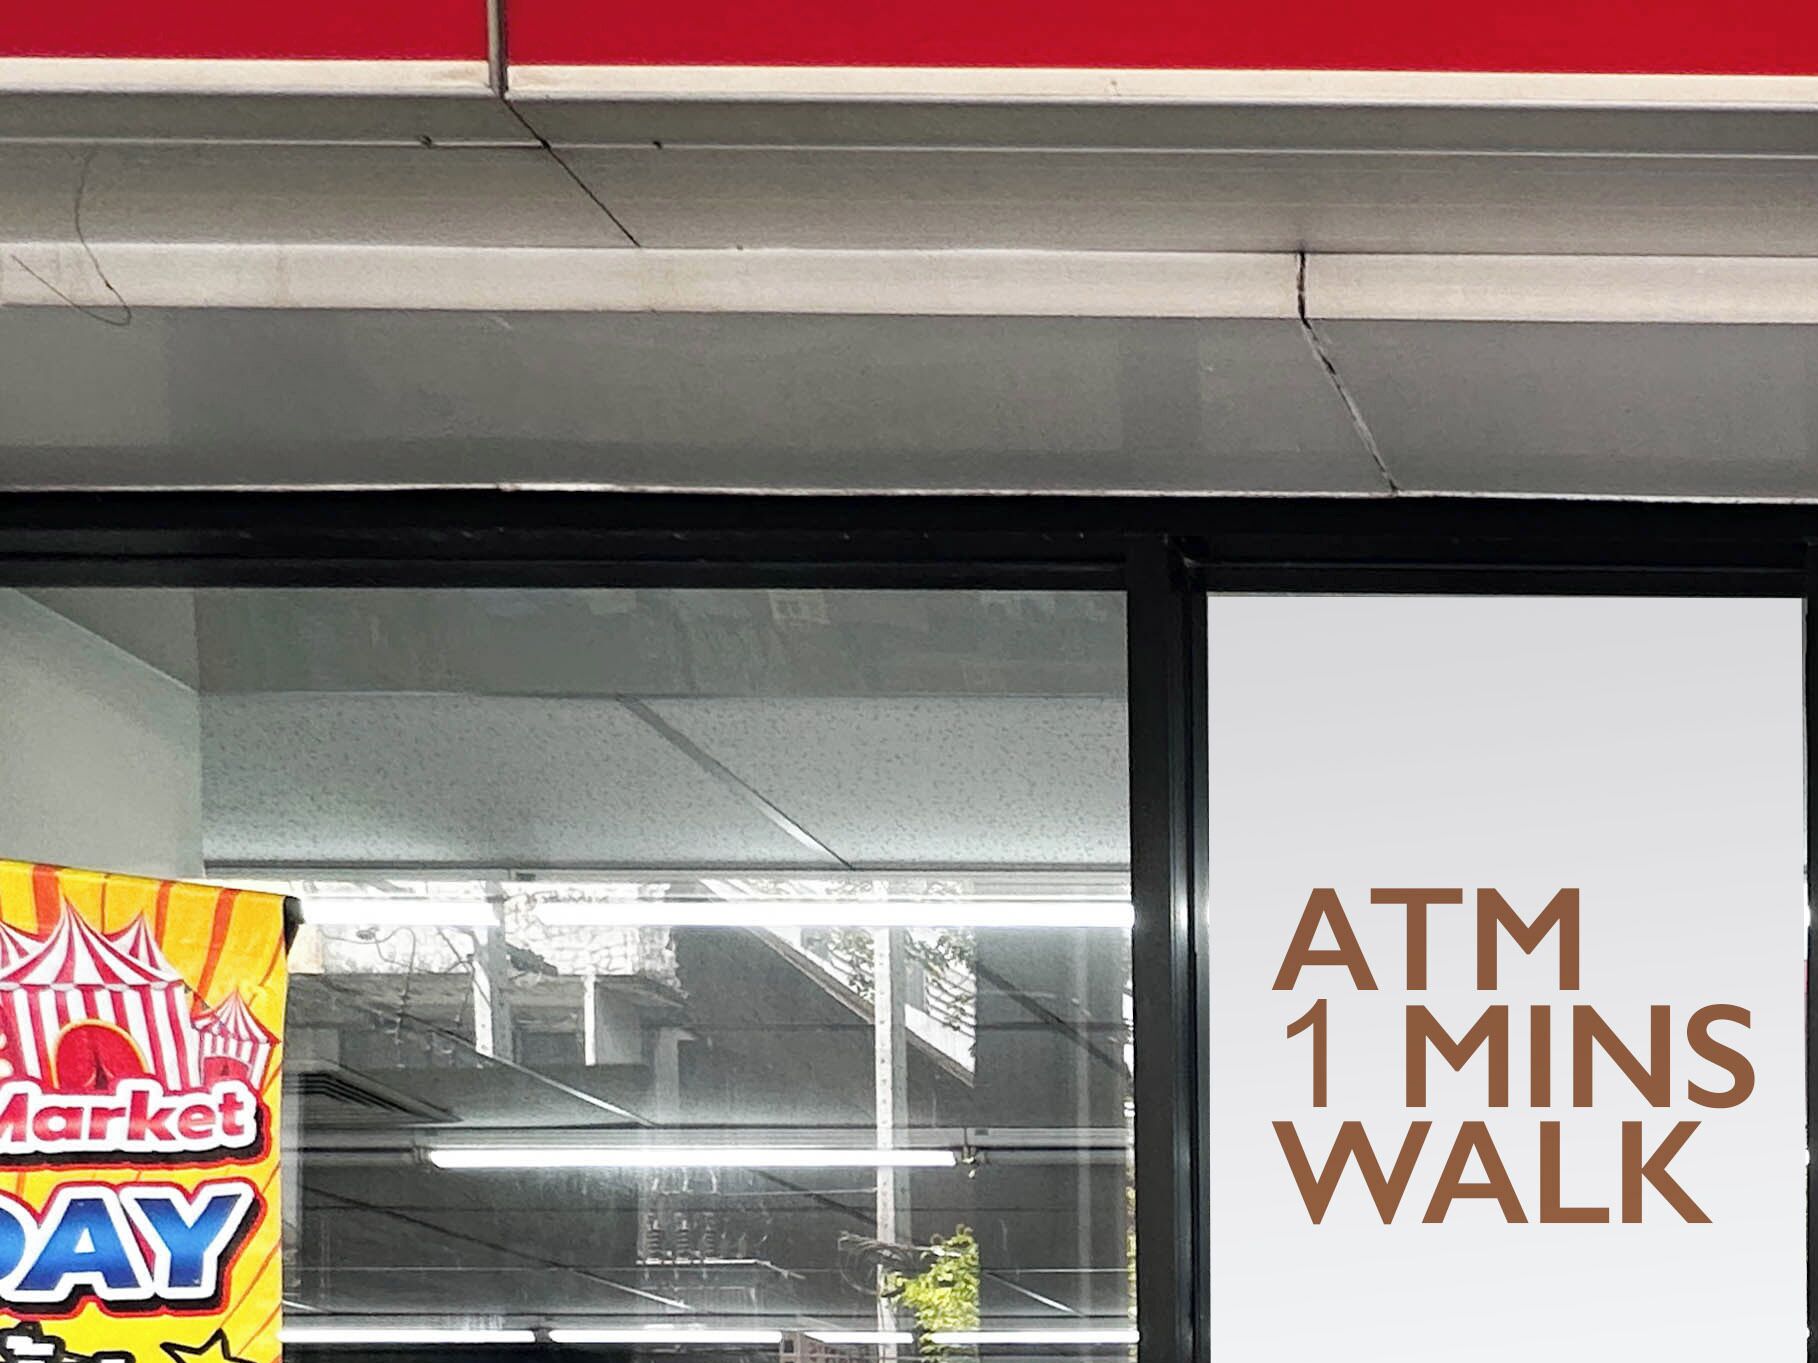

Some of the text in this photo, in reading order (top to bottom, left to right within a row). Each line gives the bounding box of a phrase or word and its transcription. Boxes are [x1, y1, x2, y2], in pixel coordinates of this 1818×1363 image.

[1272, 888, 1580, 991] ATM
[1287, 999, 1756, 1109] 1 MINS
[1272, 1121, 1713, 1225] WALK
[0, 1194, 242, 1291] AY
